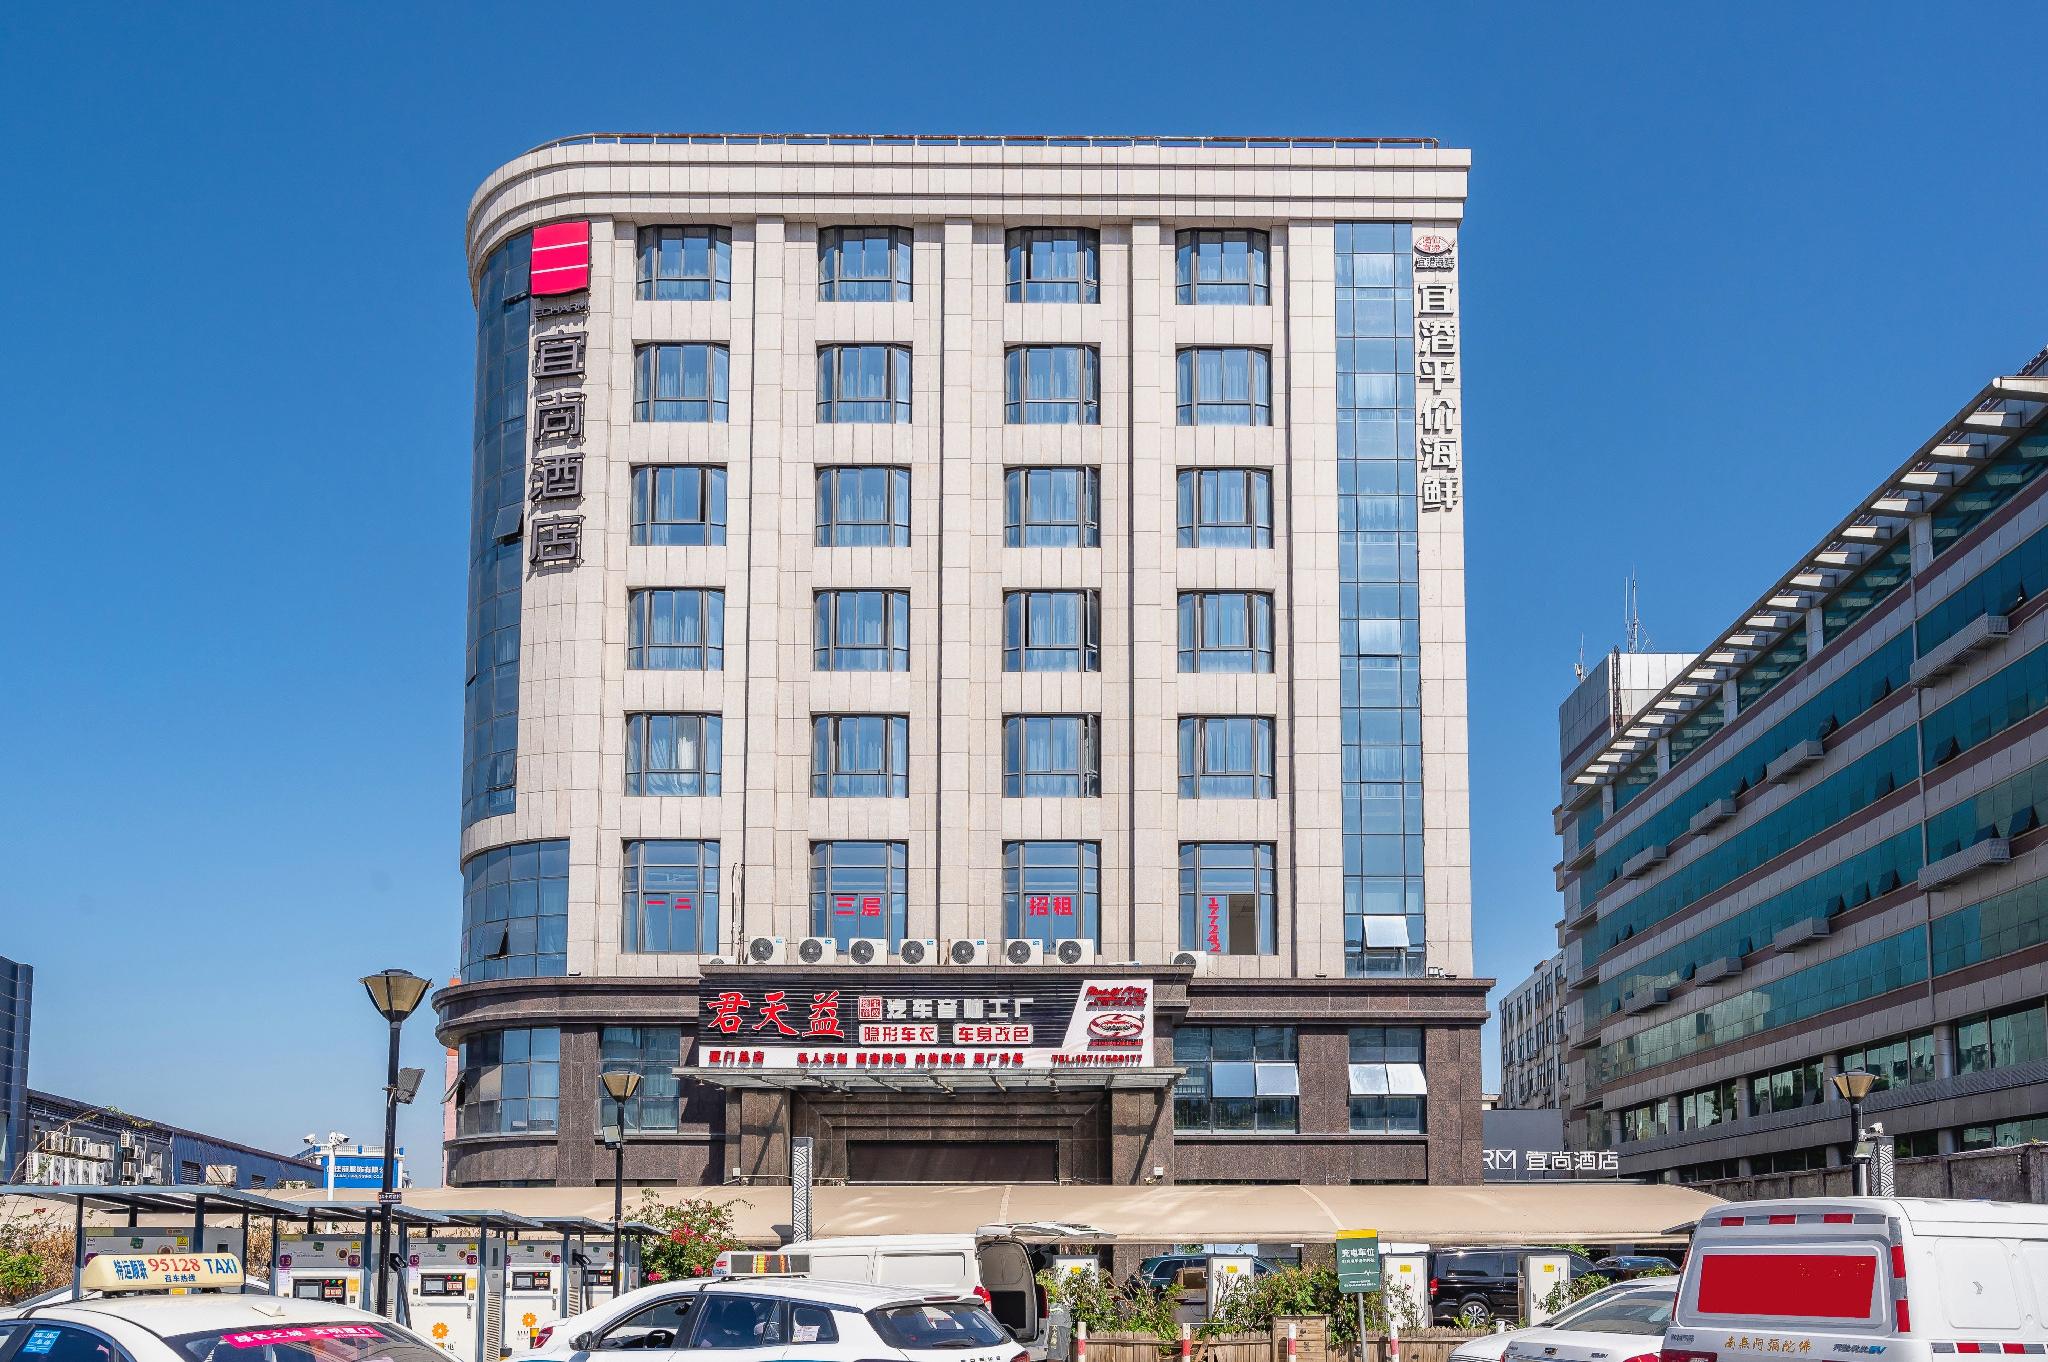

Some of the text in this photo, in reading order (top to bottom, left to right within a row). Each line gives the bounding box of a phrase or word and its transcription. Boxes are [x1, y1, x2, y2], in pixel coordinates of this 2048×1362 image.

[1419, 281, 1457, 511] 宜港平价海鲜
[530, 331, 587, 563] 宜尚酒店
[1029, 896, 1072, 916] 招租
[707, 990, 845, 1038] 君天益
[886, 998, 1034, 1018] 汽车音响工厂
[864, 1026, 935, 1042] 隐形车衣
[958, 1026, 1029, 1042] 车身改色
[1526, 1150, 1619, 1170] 宜尚酒店
[1342, 1248, 1375, 1257] 充电车位
[148, 1259, 200, 1272] 95128
[204, 1258, 238, 1274] TAXI
